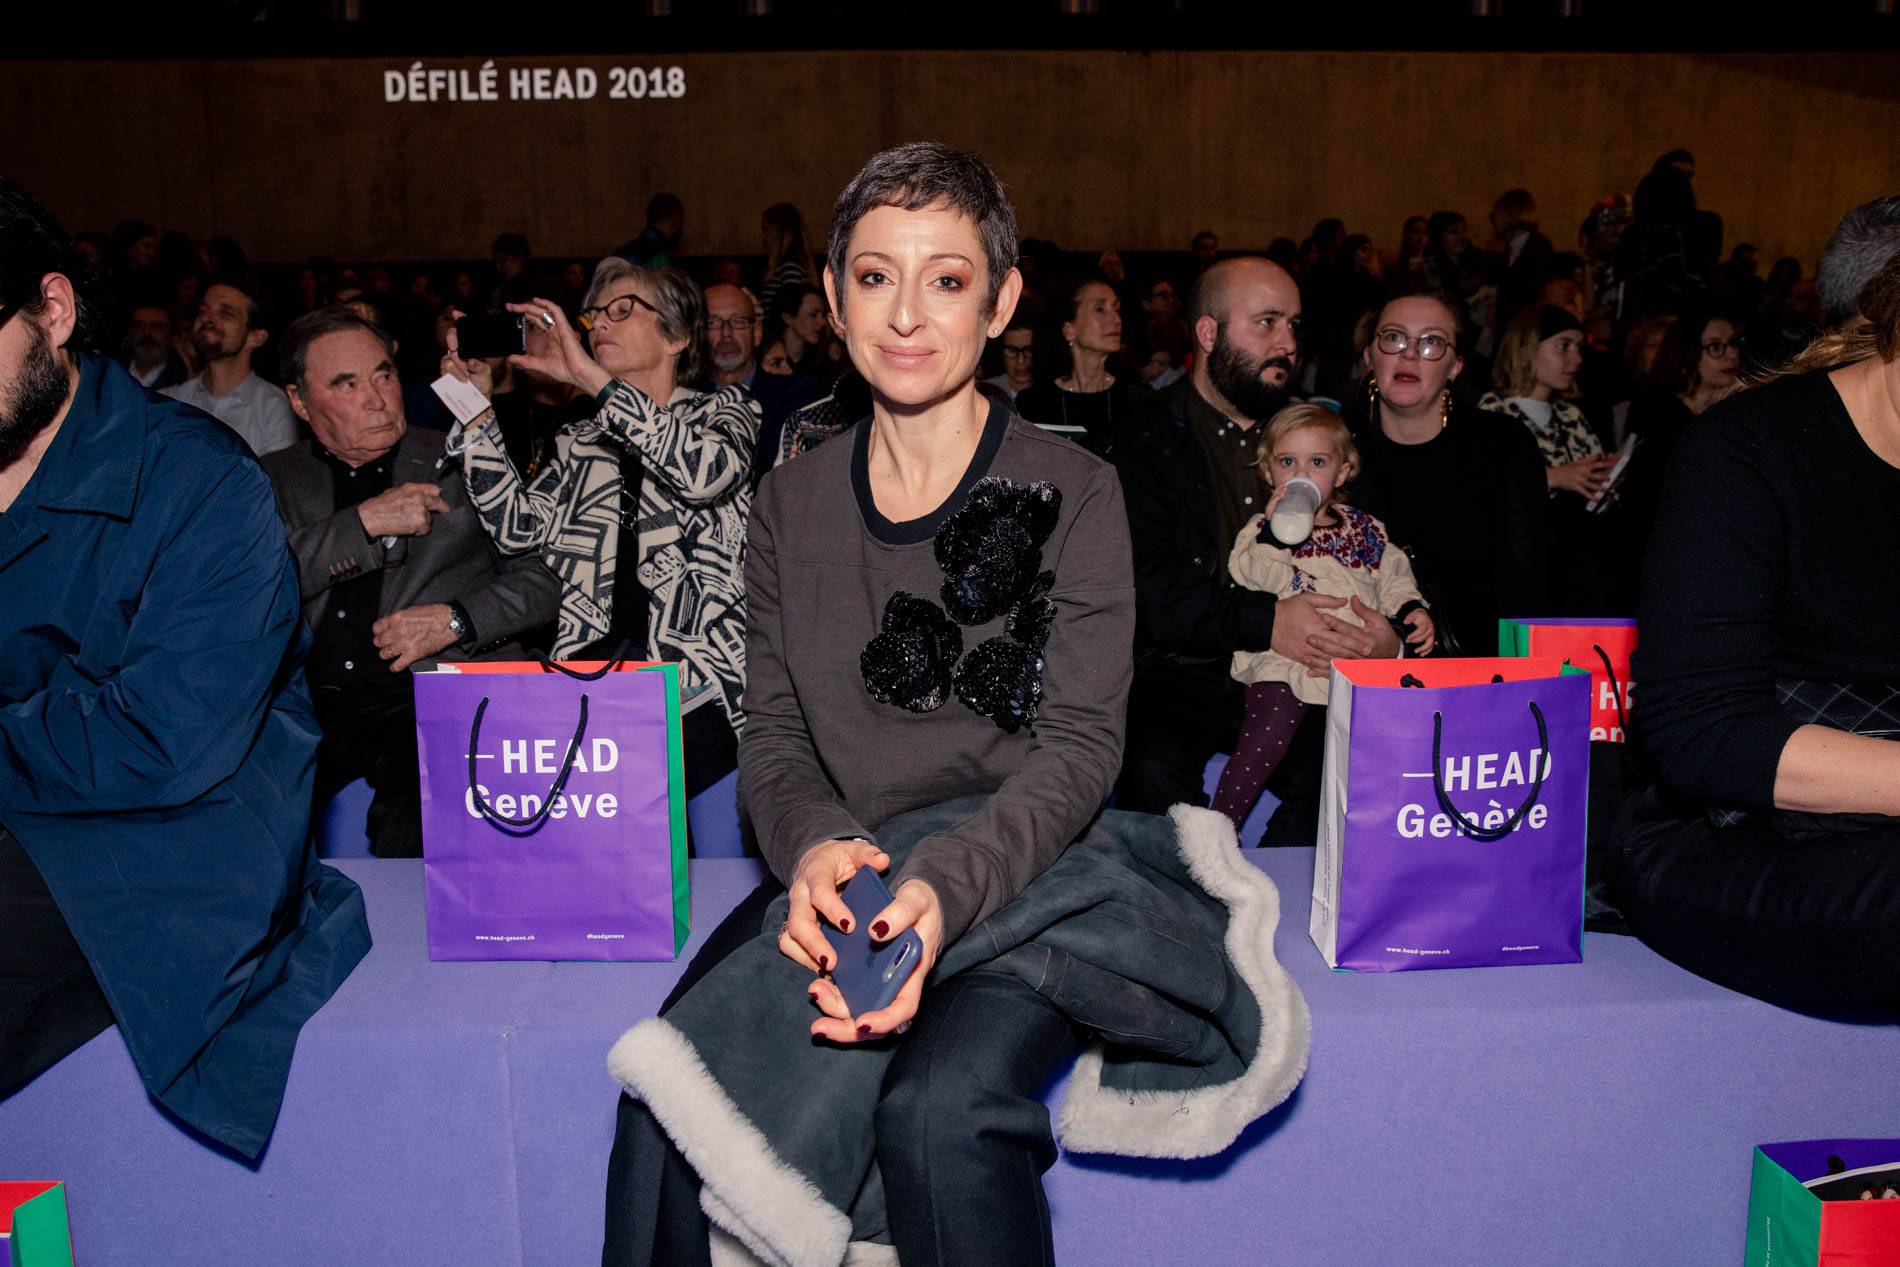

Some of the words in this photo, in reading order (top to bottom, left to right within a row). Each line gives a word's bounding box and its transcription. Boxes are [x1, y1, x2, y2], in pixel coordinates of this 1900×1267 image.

[383, 59, 499, 101] DÉFILÉ
[509, 68, 598, 99] HEAD
[608, 66, 687, 98] 2018
